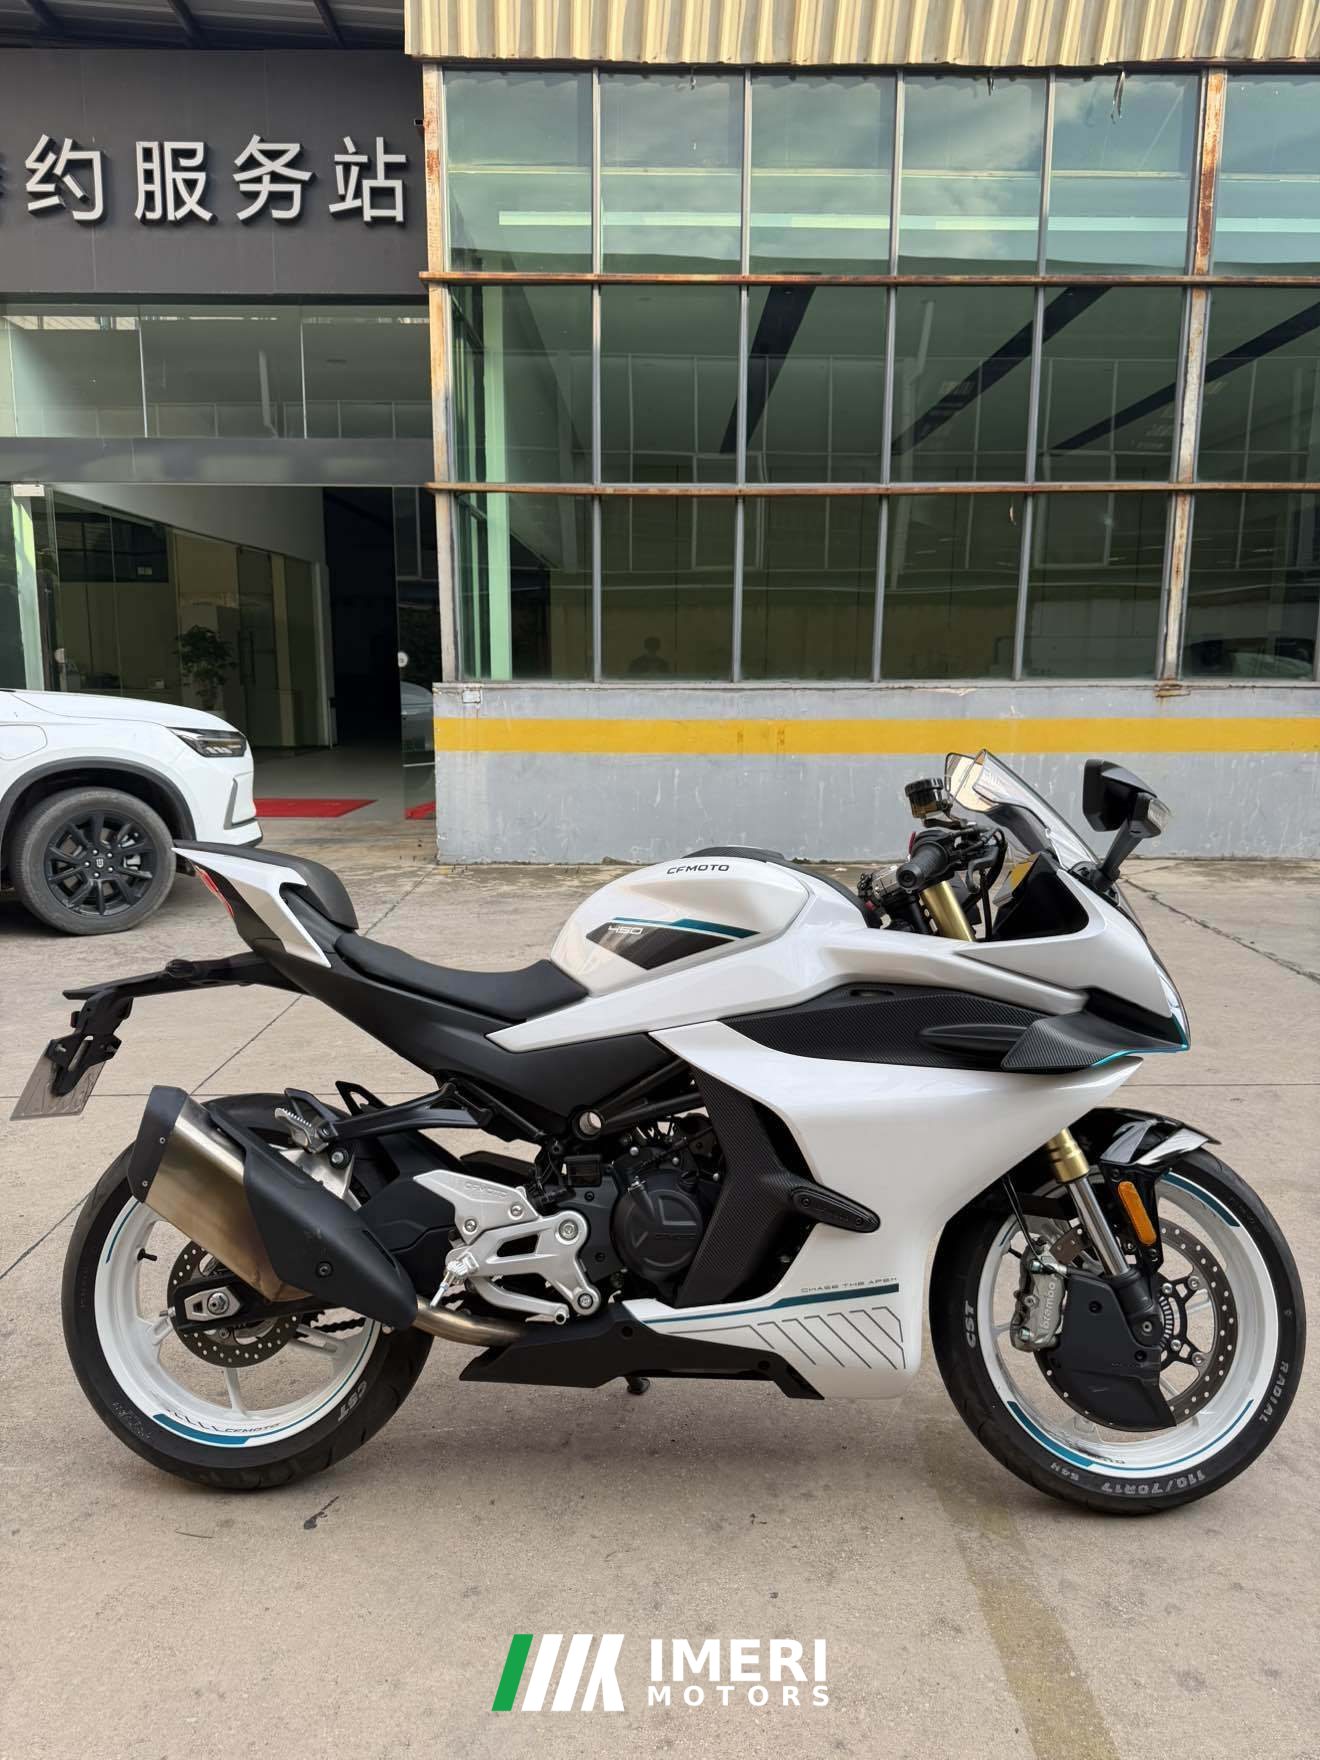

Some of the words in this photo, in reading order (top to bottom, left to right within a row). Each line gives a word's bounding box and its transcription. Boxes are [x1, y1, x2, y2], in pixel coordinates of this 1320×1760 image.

[25, 133, 407, 222] 约服务站
[666, 864, 730, 875] CFMOTO
[800, 1284, 839, 1293] CHASE
[1040, 1281, 1056, 1330] brembo
[965, 1300, 976, 1348] CST
[337, 1380, 367, 1422] CST
[1259, 1360, 1289, 1422] RADIAL
[1101, 1469, 1206, 1495] 110/70R17
